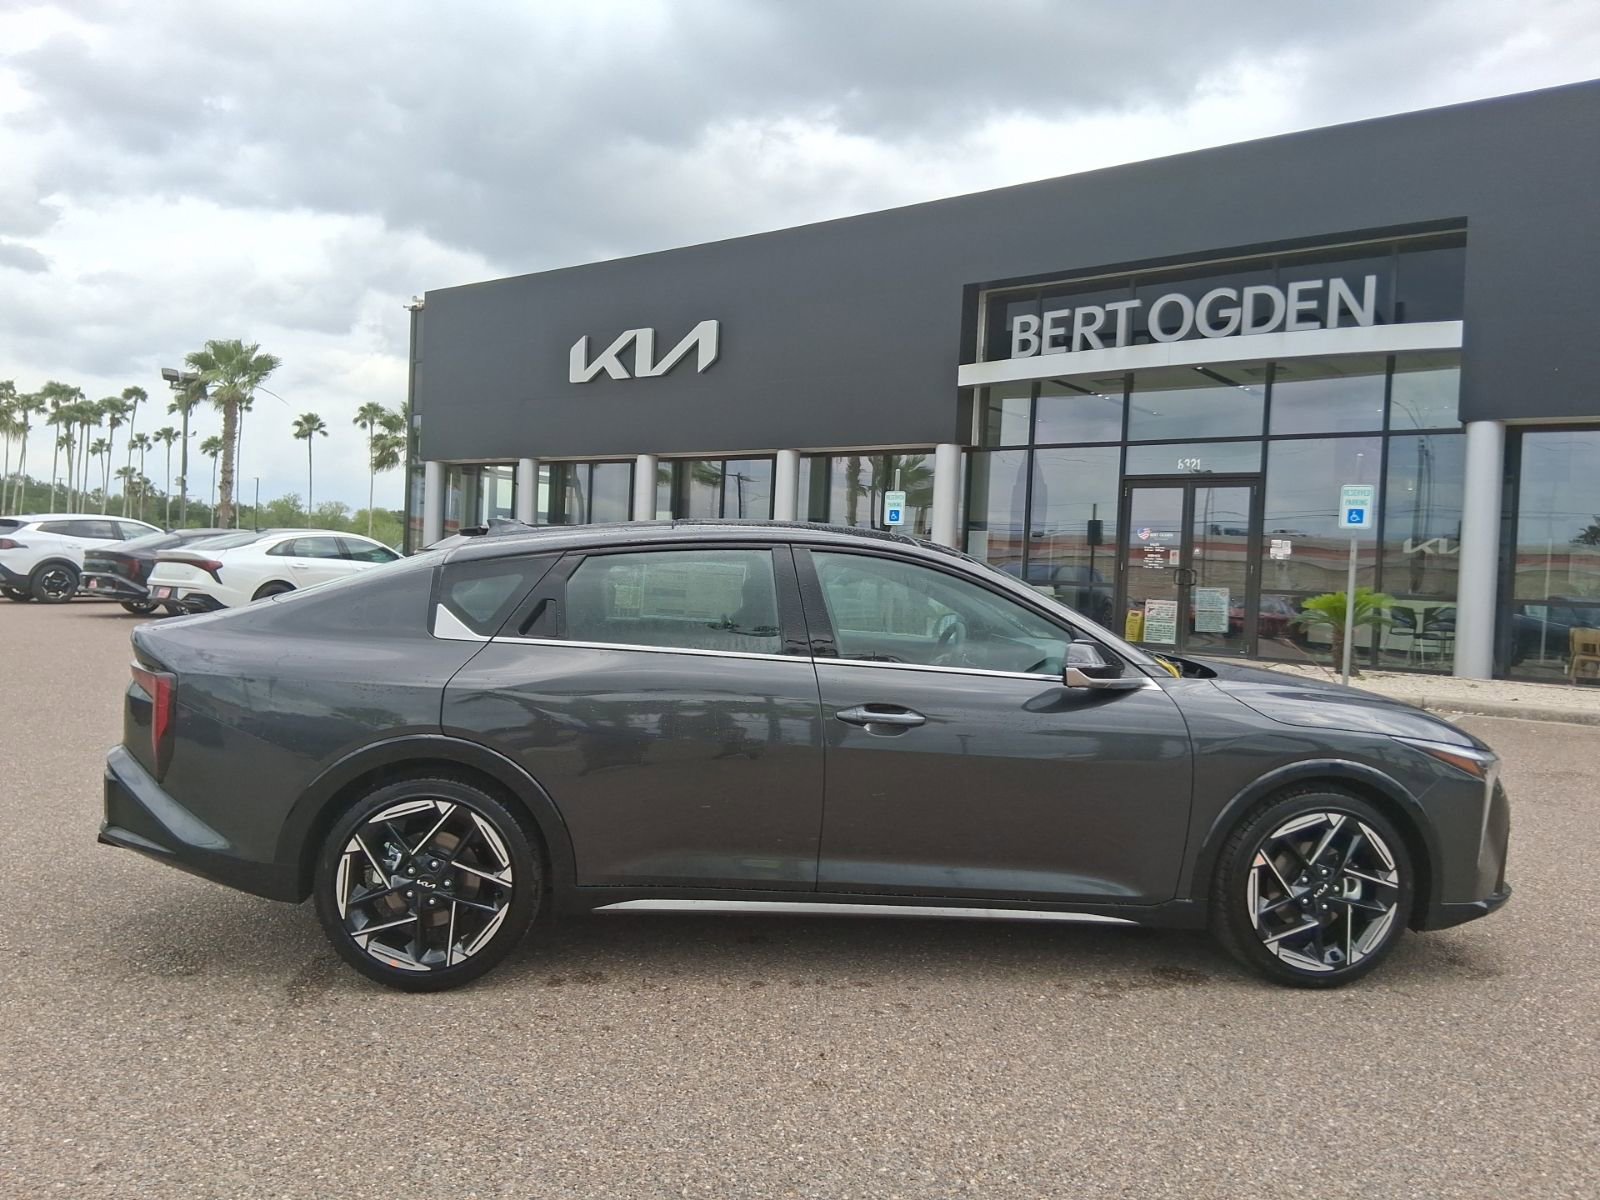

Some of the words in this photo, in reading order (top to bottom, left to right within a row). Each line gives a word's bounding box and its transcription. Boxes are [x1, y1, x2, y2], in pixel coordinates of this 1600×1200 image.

[1011, 299, 1142, 360] BERT
[1147, 275, 1377, 344] OGDEN
[569, 319, 719, 384] KIA
[416, 879, 436, 889] KIA
